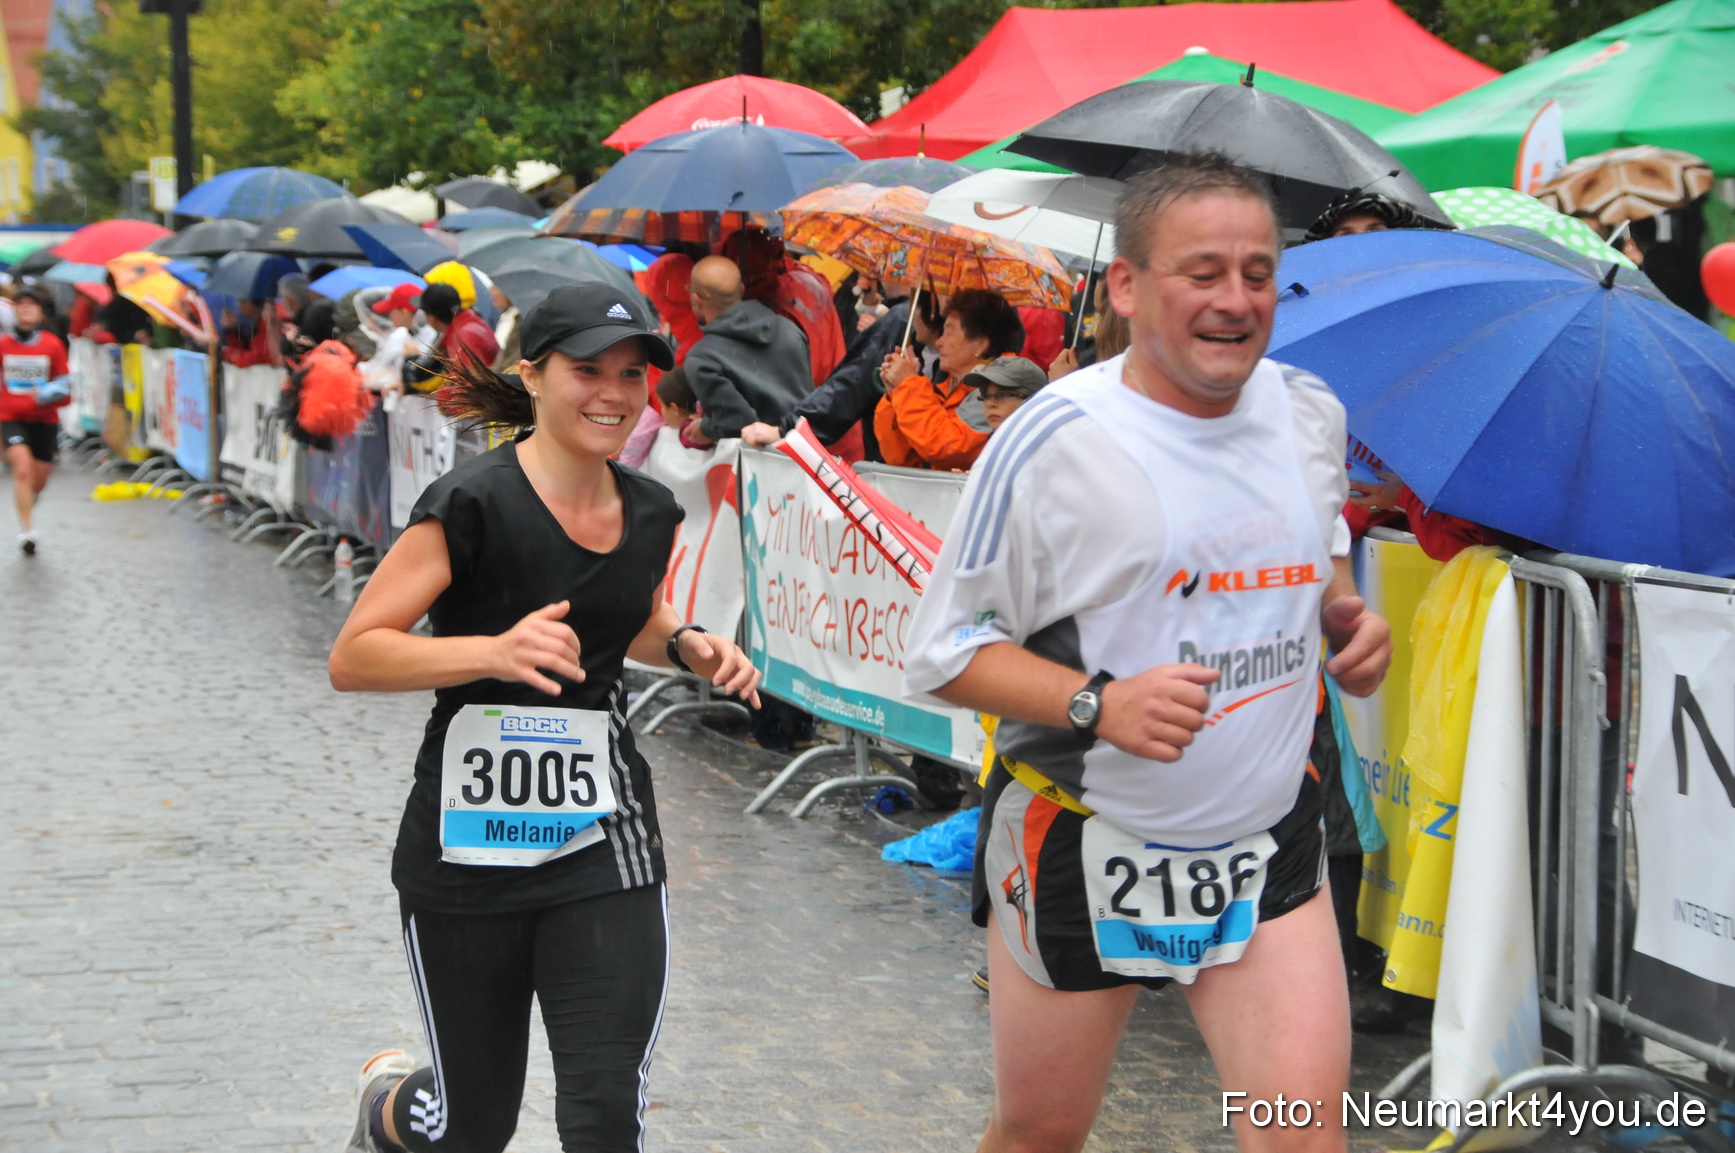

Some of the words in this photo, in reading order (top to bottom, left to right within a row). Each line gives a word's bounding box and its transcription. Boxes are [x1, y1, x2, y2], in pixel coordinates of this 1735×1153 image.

[606, 312, 632, 320] adidas
[815, 456, 932, 580] AUSTRIA
[1208, 563, 1324, 593] KLEBL
[844, 597, 909, 671] BESS
[501, 715, 569, 734] BOCK
[461, 747, 598, 808] 3005
[449, 797, 456, 808] D
[485, 819, 576, 843] Melanie
[1104, 851, 1260, 918] 2186
[1097, 907, 1107, 918] B
[1672, 899, 1735, 941] INTERNET
